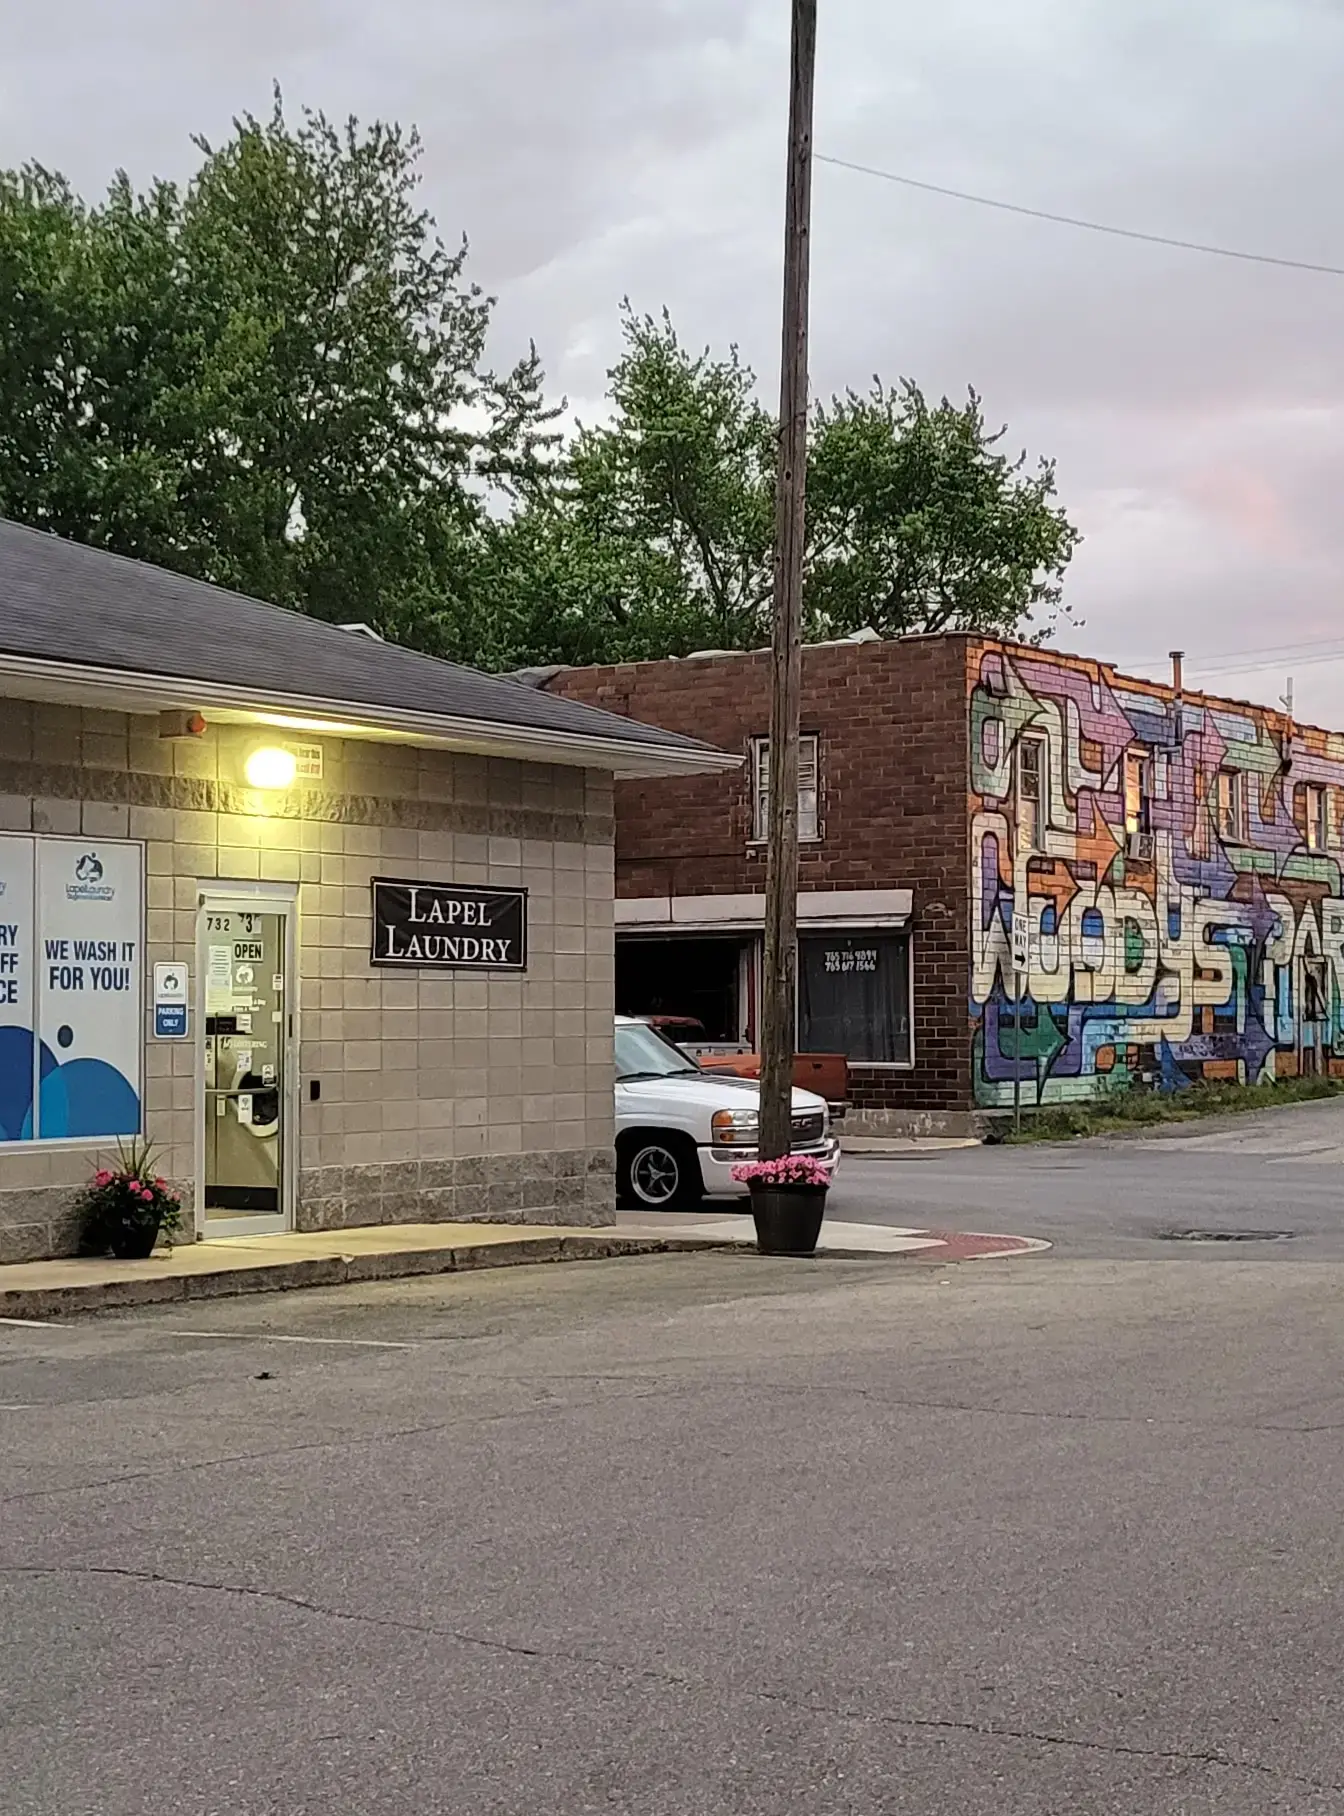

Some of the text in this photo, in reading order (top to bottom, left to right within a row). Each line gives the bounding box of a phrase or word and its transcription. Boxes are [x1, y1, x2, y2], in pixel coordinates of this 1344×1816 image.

[408, 888, 492, 926] LAPEL
[206, 917, 230, 931] 732
[1015, 917, 1027, 933] ONE
[385, 925, 511, 961] LAUNDRY
[1015, 933, 1027, 948] WAY
[45, 940, 136, 962] WE WASH IT
[234, 943, 262, 959] OPEN
[825, 951, 840, 961] 765
[825, 960, 840, 972] 765
[49, 966, 130, 991] FOR YOU!
[158, 1007, 184, 1016] PARKING
